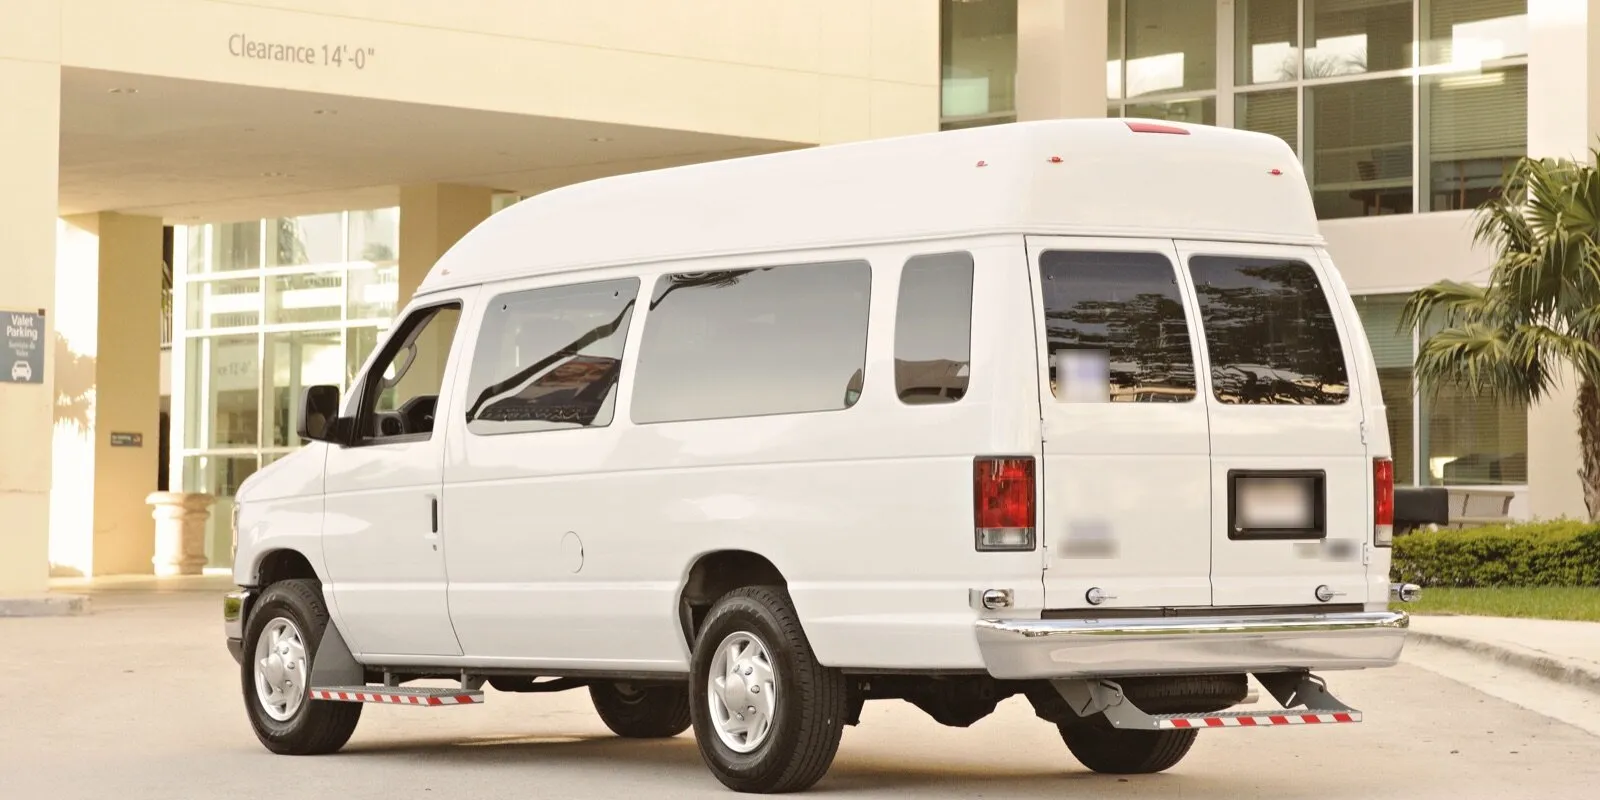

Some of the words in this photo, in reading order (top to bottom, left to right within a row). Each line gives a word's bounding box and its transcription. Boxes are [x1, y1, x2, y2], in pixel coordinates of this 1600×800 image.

[228, 33, 315, 64] Clearance
[321, 44, 375, 70] 14'-0"
[11, 314, 33, 327] Valet
[6, 325, 38, 340] Parking
